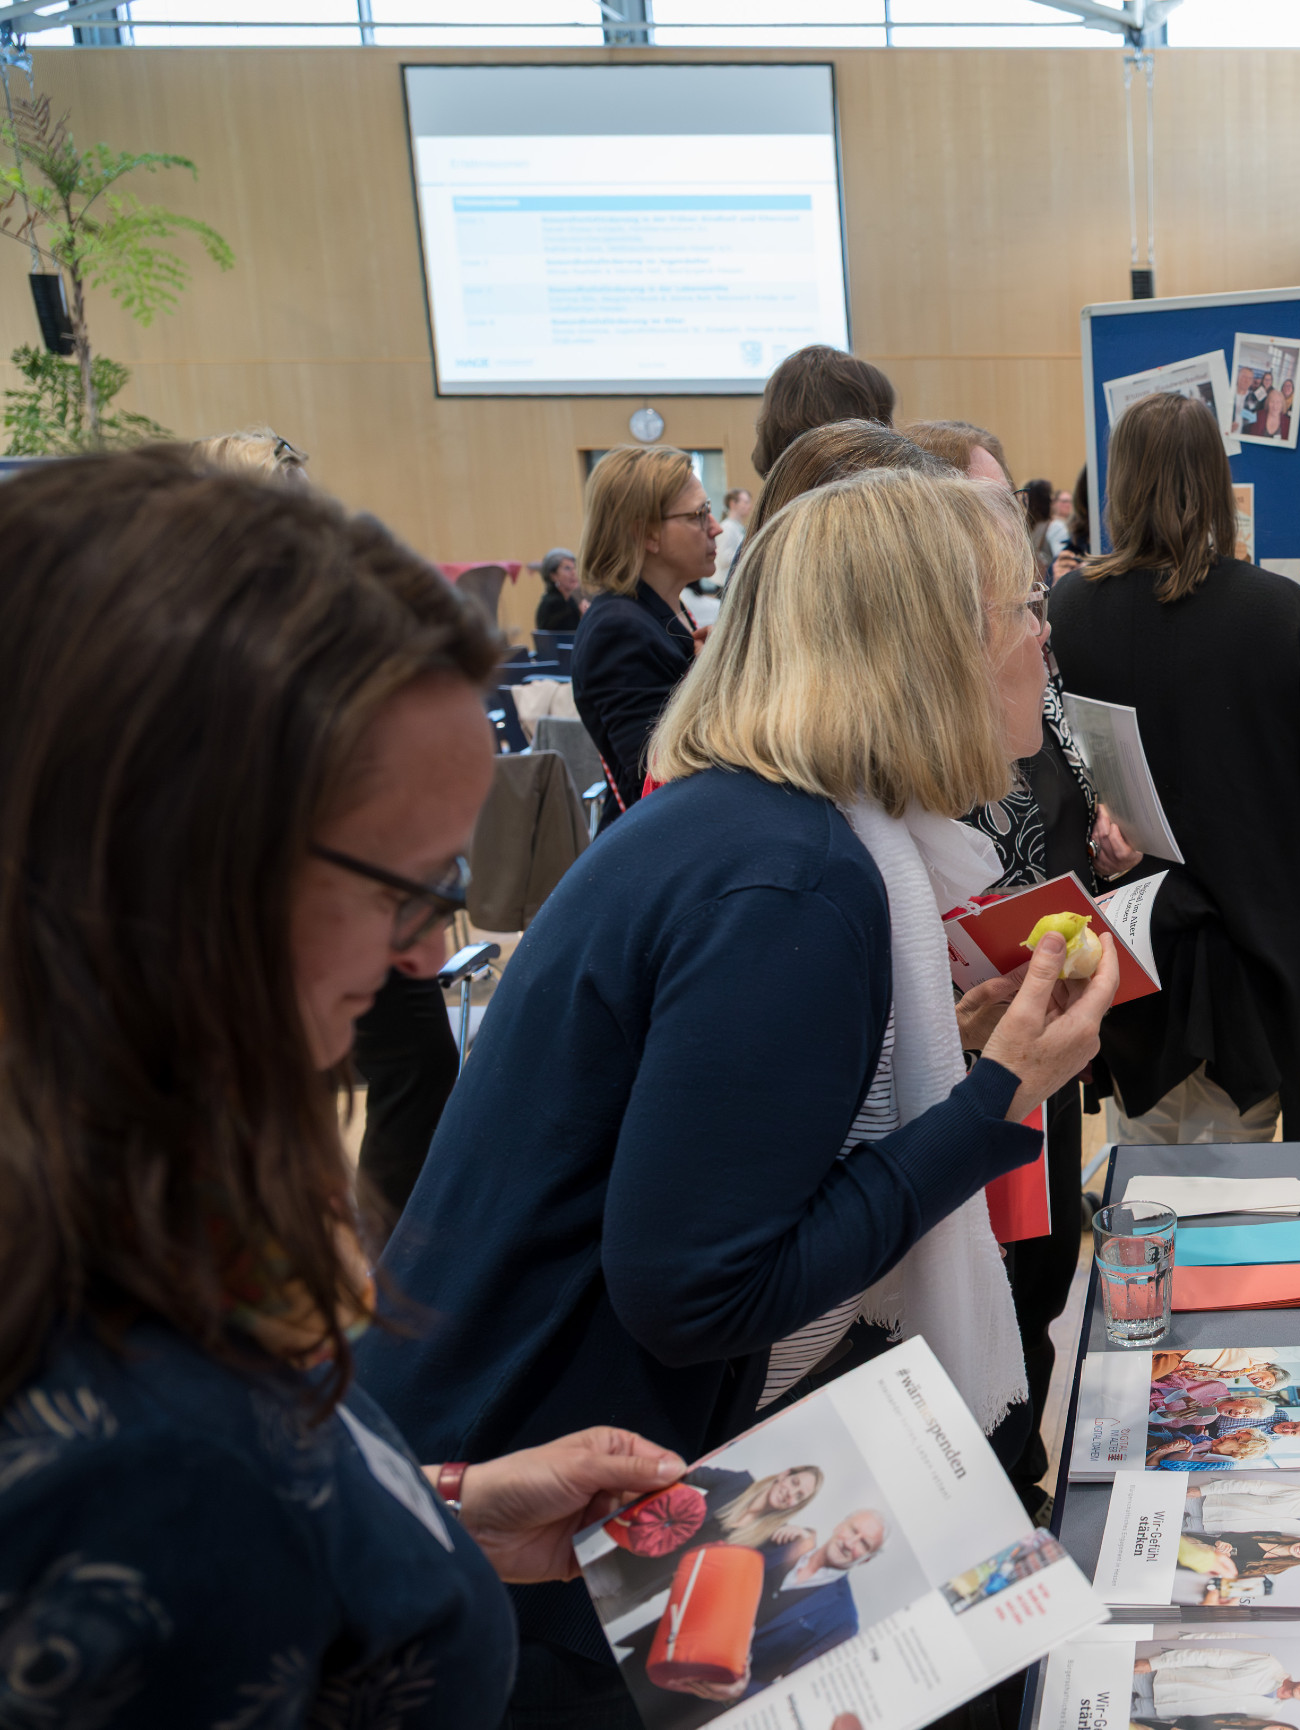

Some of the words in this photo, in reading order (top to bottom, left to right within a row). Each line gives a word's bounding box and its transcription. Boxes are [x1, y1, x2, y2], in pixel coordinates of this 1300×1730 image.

[896, 1368, 967, 1480] #wärmespenden
[1093, 1422, 1103, 1441] DIGITAL
[1090, 1442, 1101, 1461] DAHEIM
[1109, 1437, 1118, 1452] ALTER
[1119, 1428, 1130, 1452] DIGITAL
[1134, 1516, 1149, 1556] stärken
[1146, 1511, 1165, 1562] Wir-Gefühl
